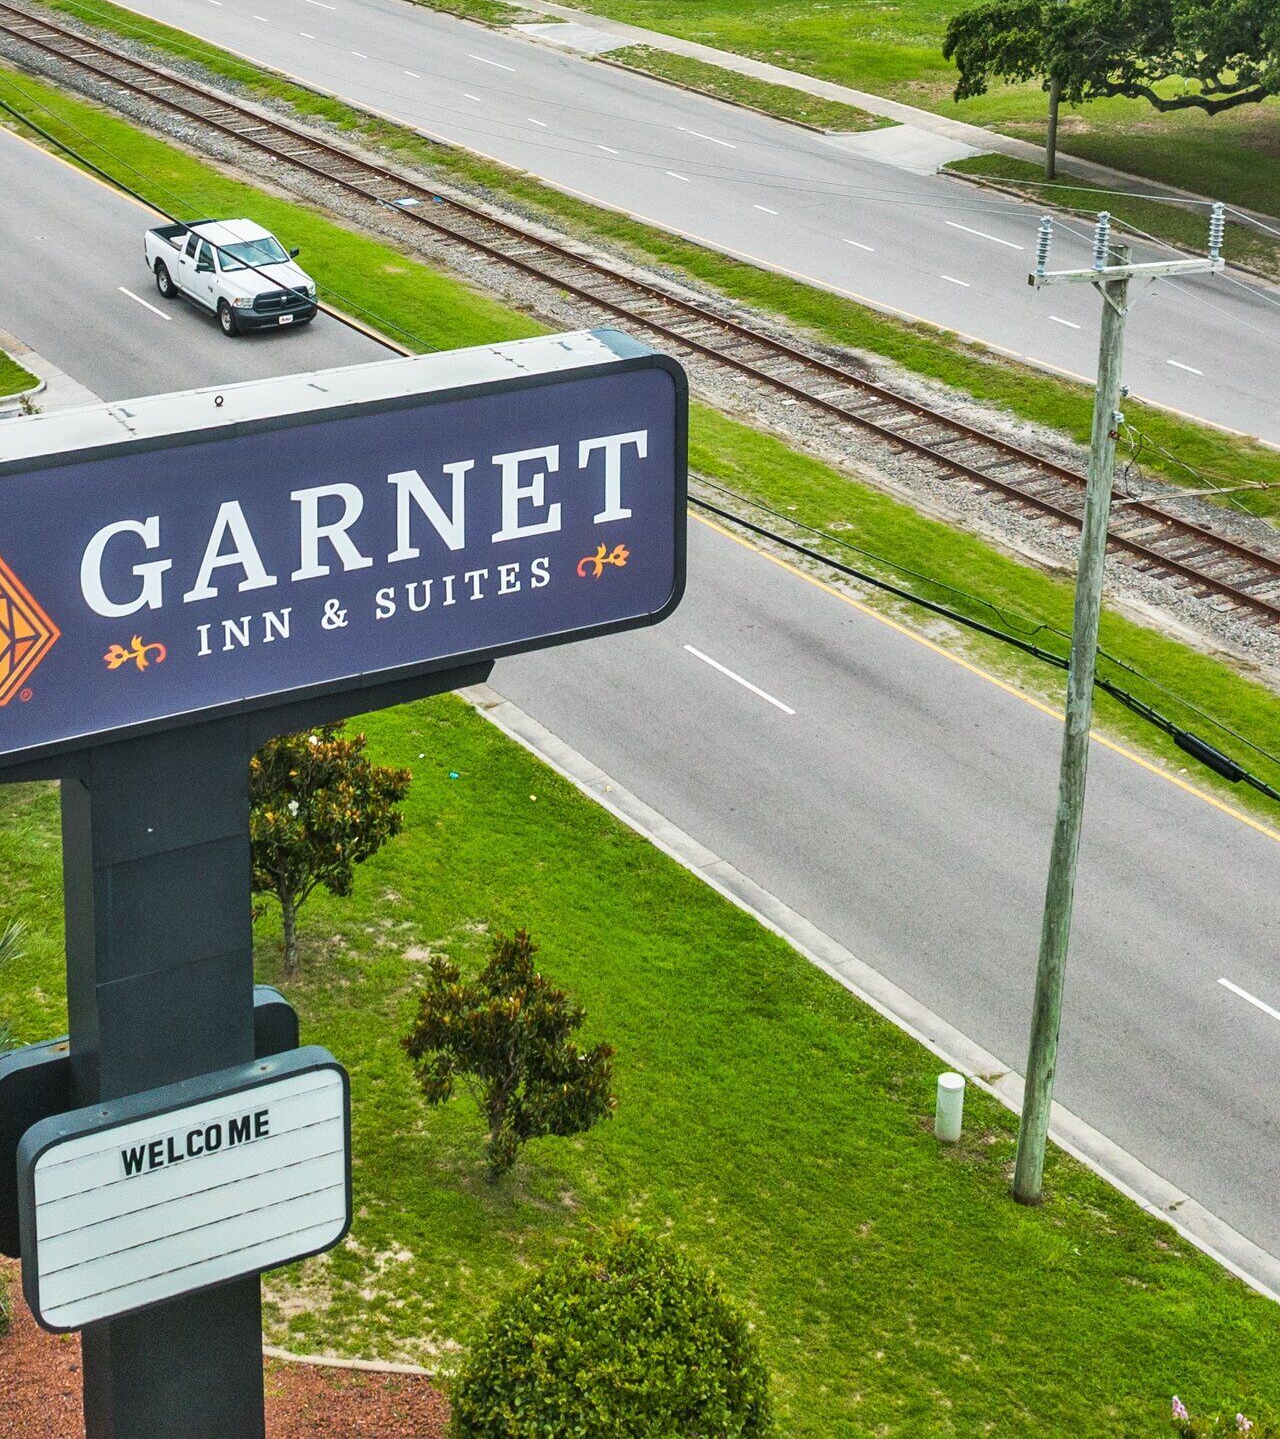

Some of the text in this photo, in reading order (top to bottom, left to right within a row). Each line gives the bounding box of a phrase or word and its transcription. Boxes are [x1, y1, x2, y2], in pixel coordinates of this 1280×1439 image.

[80, 430, 648, 618] GARNET
[197, 557, 551, 656] INN & SUITES
[121, 1109, 269, 1176] WELCOME
